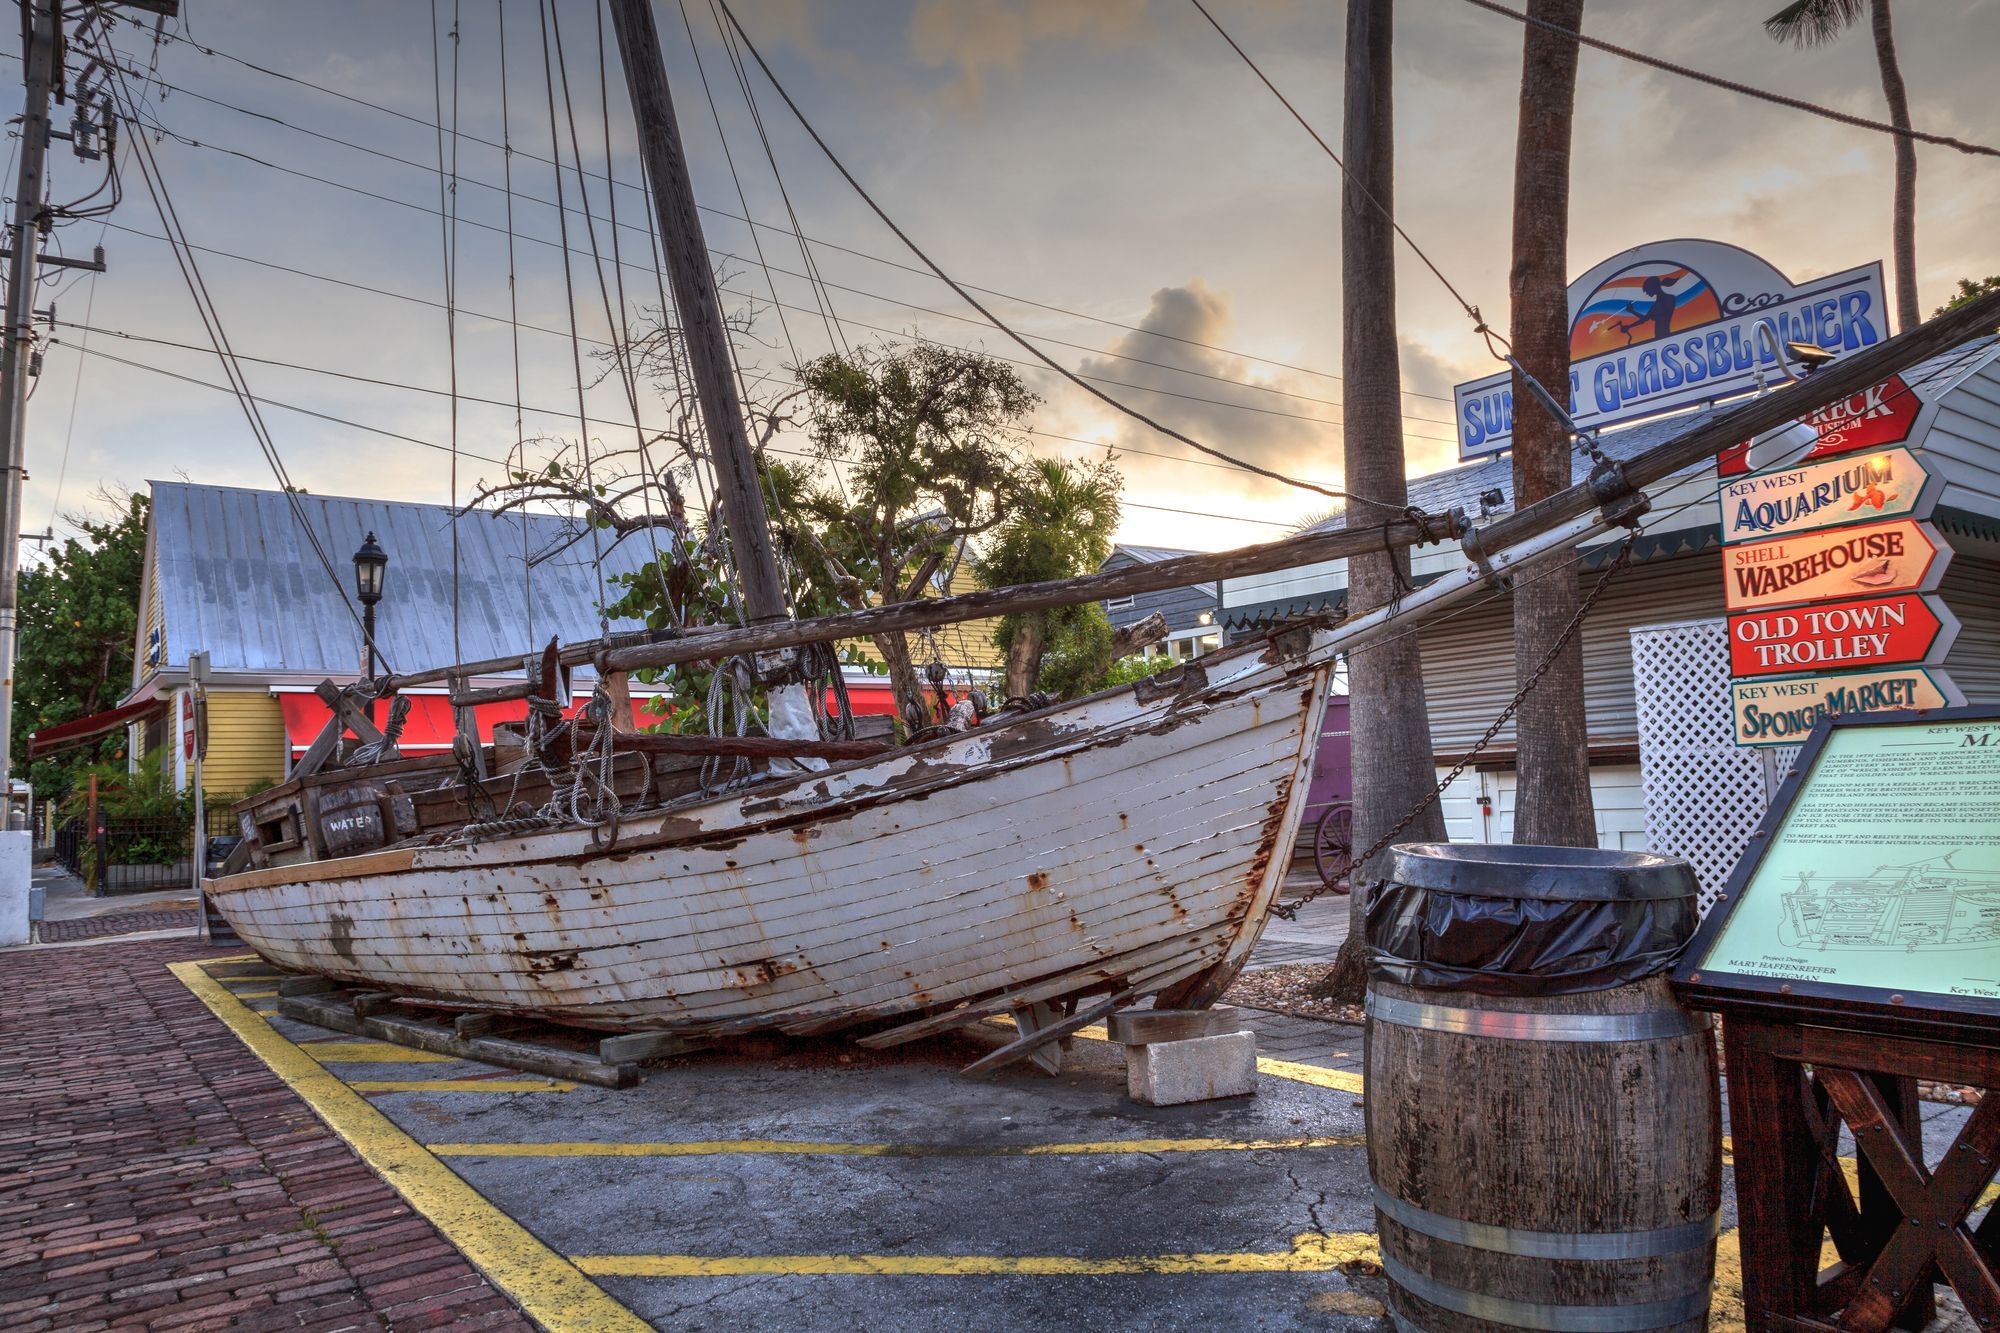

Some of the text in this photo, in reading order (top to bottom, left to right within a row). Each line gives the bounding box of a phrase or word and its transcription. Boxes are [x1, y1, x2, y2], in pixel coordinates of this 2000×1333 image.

[1594, 289, 1878, 414] GLASSBLOWER
[1728, 471, 1808, 498] KEY WEST
[1733, 454, 1893, 533] AQUARIUM
[1733, 531, 1904, 599] WAREHOUSE
[1735, 545, 1790, 566] SHELL
[1736, 602, 1907, 643] OLD TOWN
[1753, 632, 1891, 667] TROLLEY
[1738, 682, 1819, 700] KEY WEST
[1742, 678, 1918, 739] SPONGE MARKET
[1728, 959, 1836, 974] MARY HAFFENREFFER
[1736, 968, 1768, 976] DAVID
[1950, 986, 1998, 996] Key West
